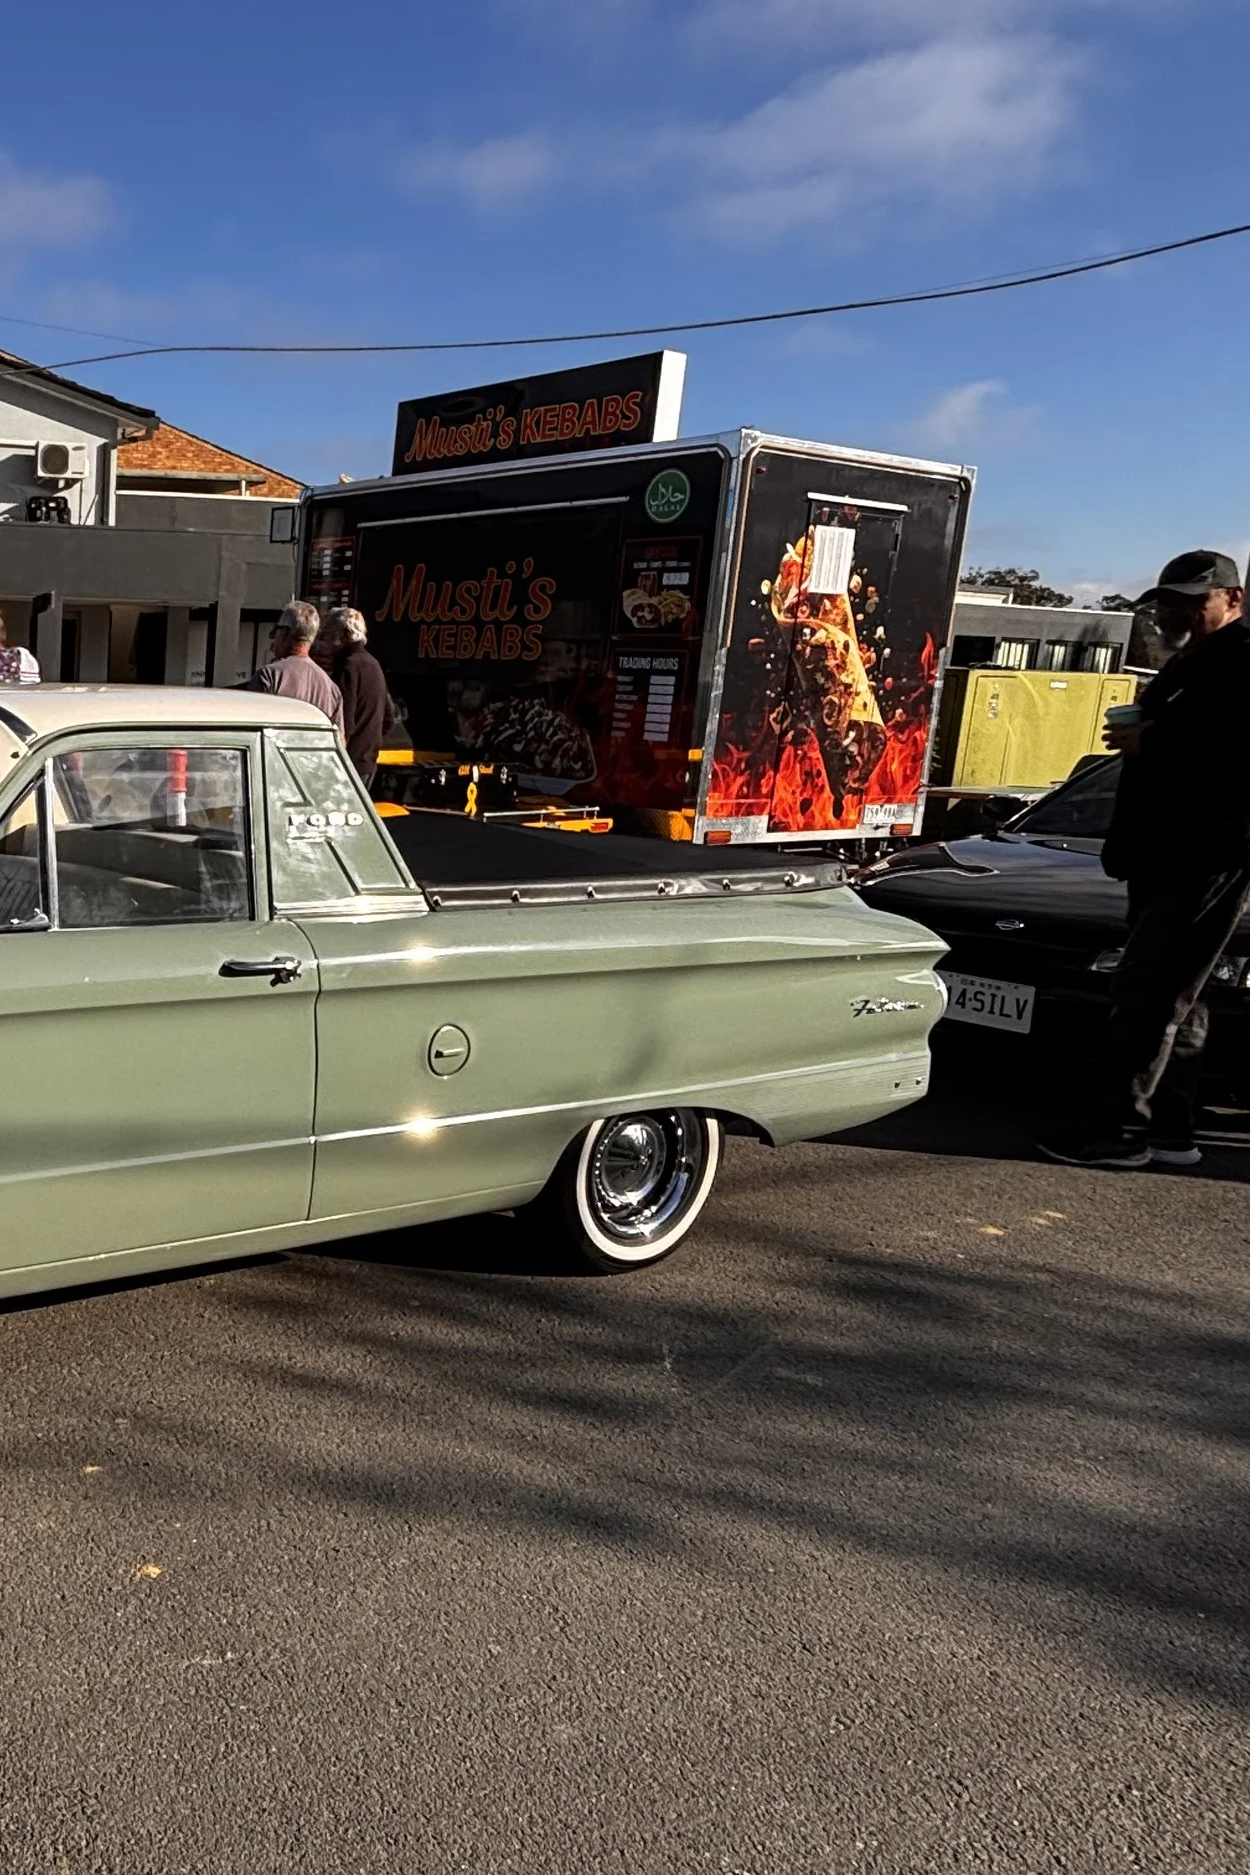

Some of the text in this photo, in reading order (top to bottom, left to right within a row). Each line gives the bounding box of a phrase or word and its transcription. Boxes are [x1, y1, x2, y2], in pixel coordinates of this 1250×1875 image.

[404, 391, 643, 463] Musti's KEBABS
[650, 482, 686, 506] حلال
[375, 557, 557, 622] Musti's
[418, 624, 544, 661] KEBABS
[618, 656, 679, 670] TRADING HOURS
